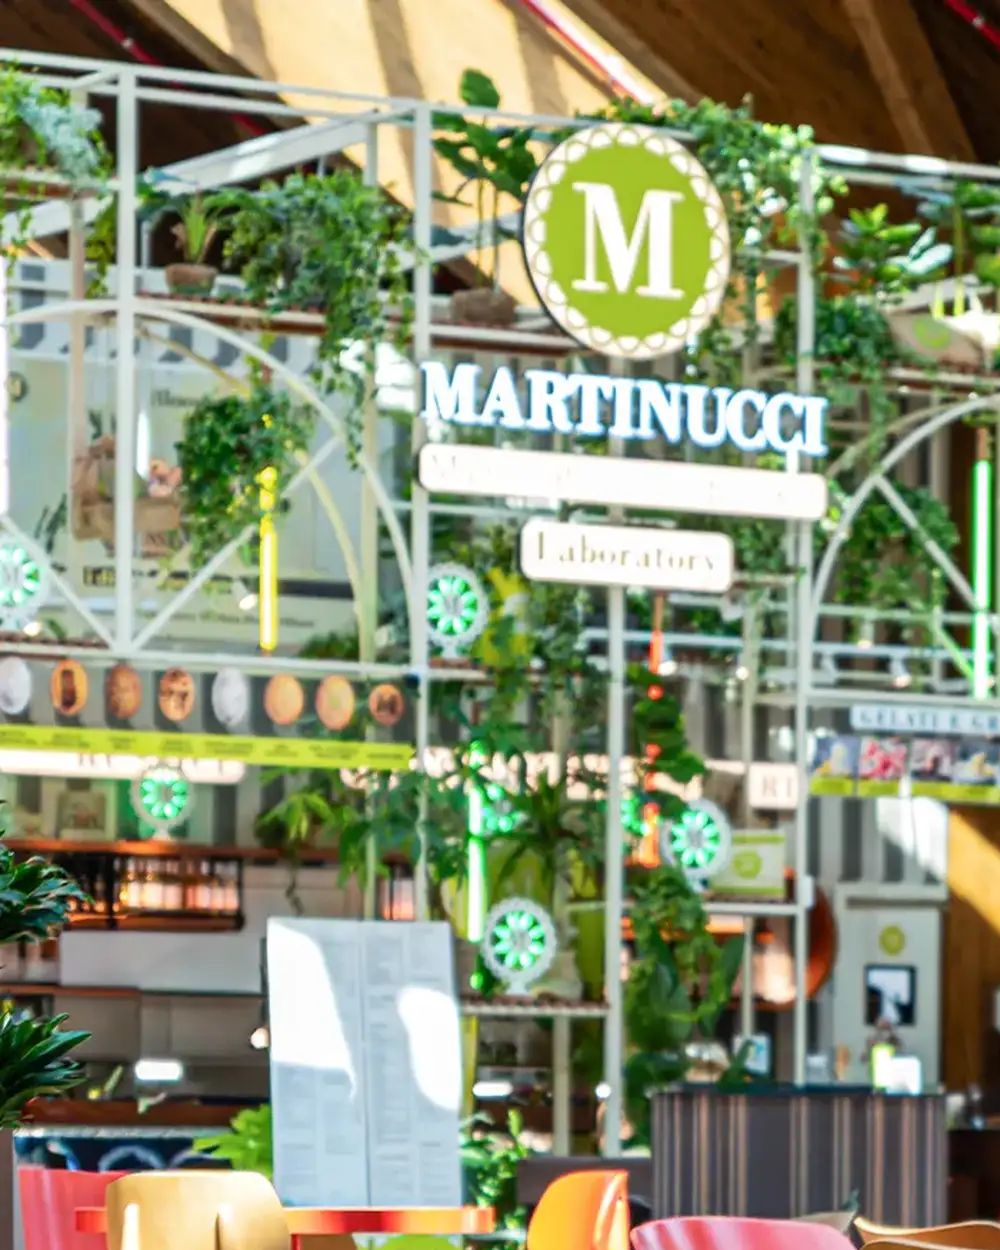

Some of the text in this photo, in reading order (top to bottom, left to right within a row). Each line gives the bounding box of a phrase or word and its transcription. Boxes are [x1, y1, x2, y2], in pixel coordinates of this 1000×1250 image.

[572, 181, 686, 299] M
[420, 362, 829, 456] MARTINUCCI
[536, 530, 715, 573] Laboratory
[860, 709, 937, 731] GELATI
